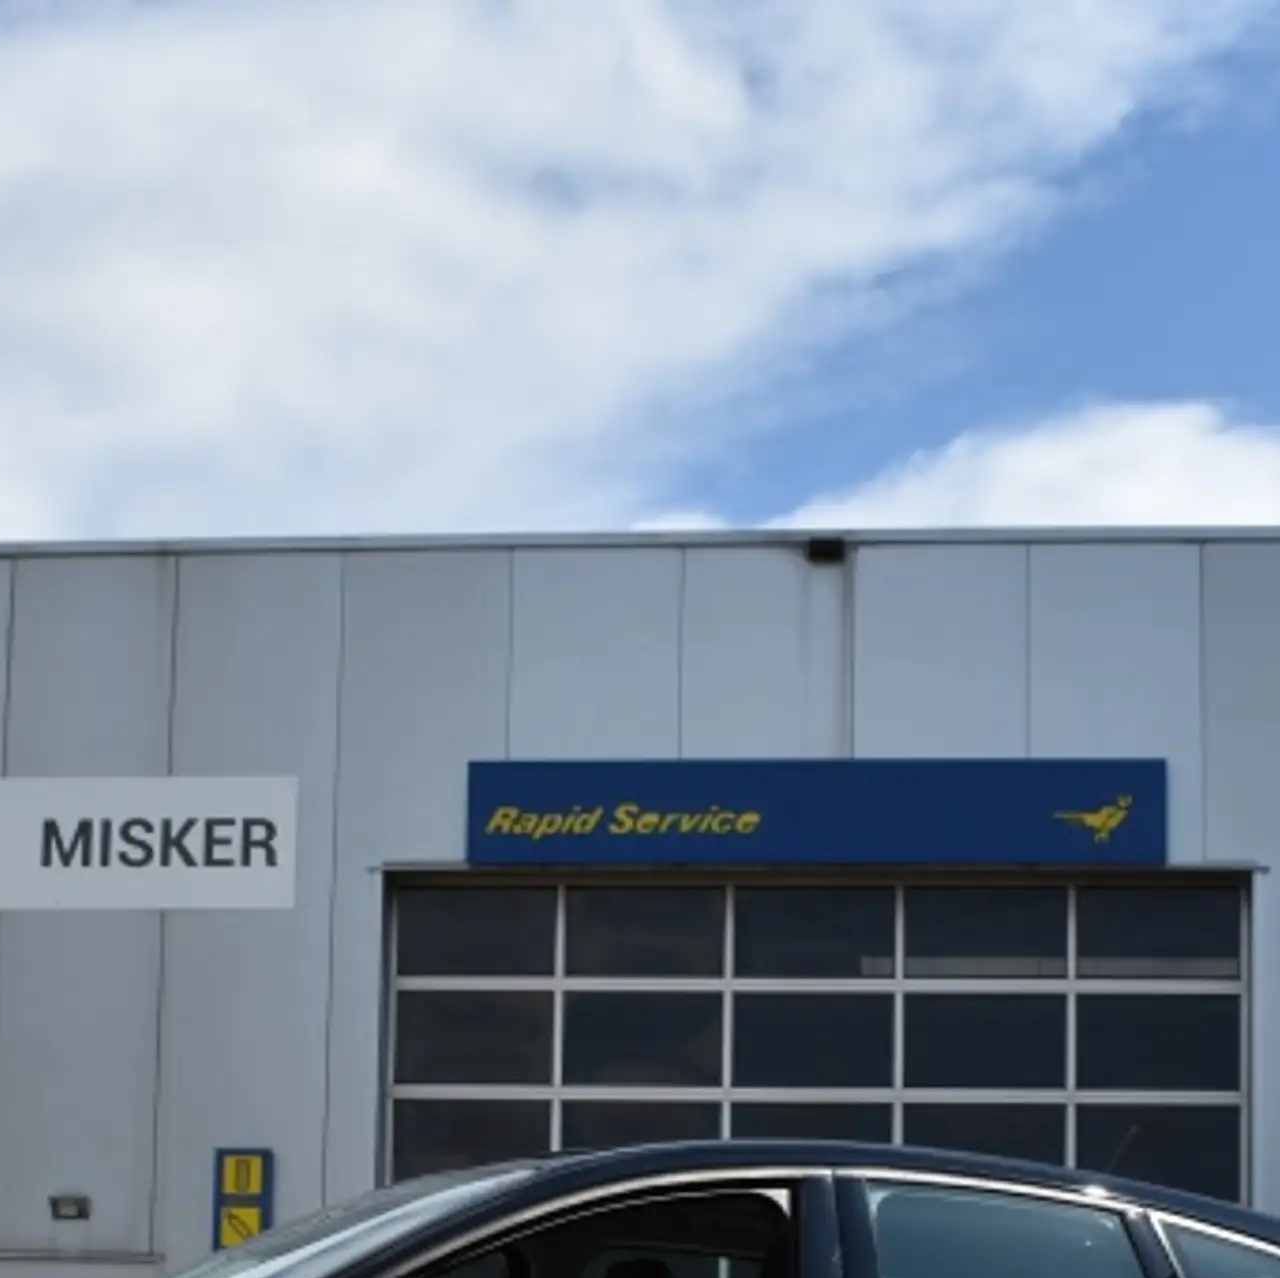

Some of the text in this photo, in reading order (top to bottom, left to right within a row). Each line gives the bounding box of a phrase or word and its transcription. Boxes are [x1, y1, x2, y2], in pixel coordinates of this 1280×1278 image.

[39, 817, 279, 869] MISKER
[485, 801, 762, 840] Rapid Service
